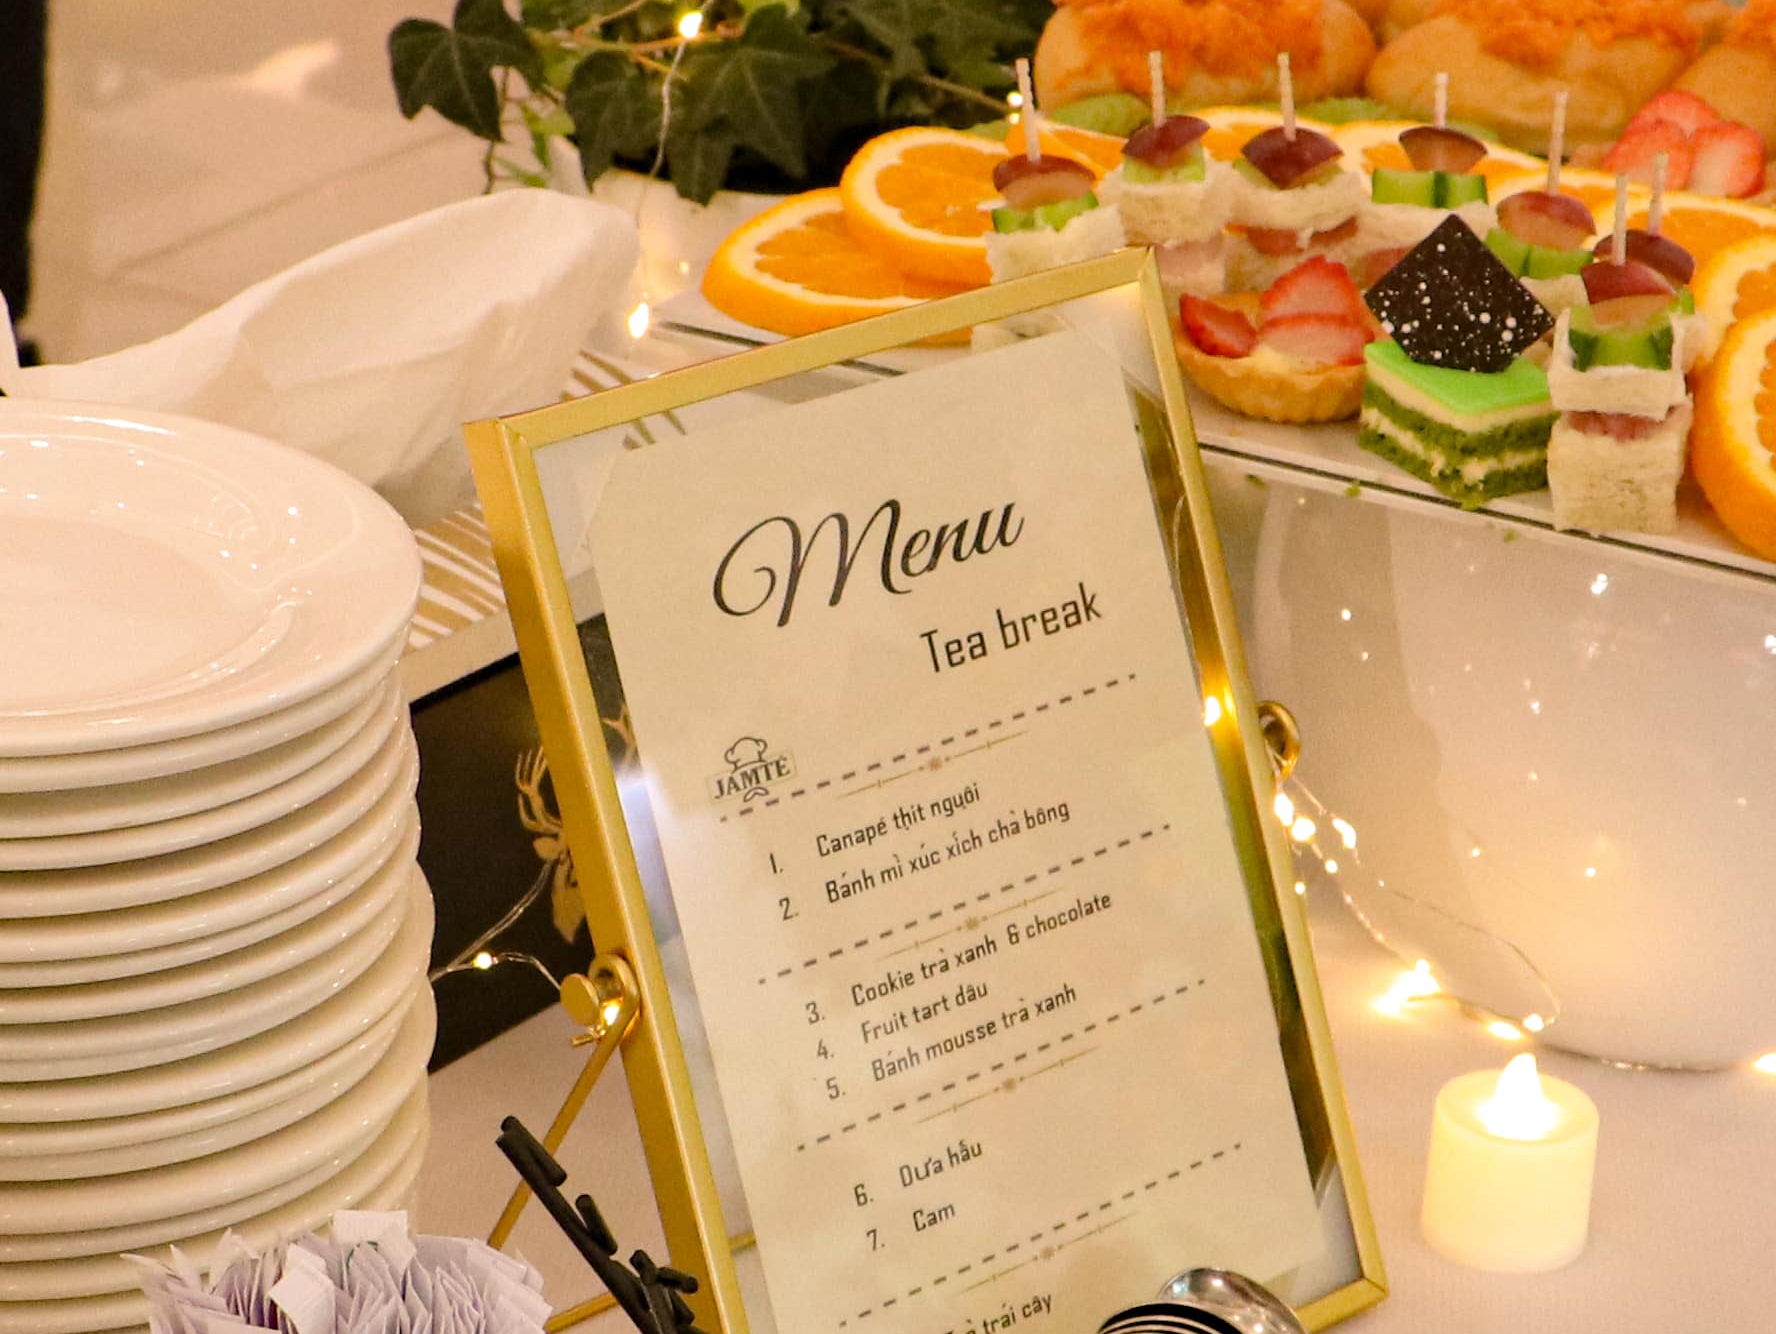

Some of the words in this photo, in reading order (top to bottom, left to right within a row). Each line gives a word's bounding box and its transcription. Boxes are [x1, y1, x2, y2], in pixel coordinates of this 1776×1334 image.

[711, 498, 1025, 628] Menu
[919, 628, 989, 674] Tea
[995, 581, 1103, 652] break
[769, 852, 784, 874] 1.
[815, 817, 889, 858] Canapé
[892, 802, 927, 831] thịt
[930, 781, 981, 818] nguội
[778, 896, 800, 921] 2.
[825, 866, 876, 904] Bánh
[880, 853, 905, 885] mì
[908, 841, 942, 875] xúc
[946, 829, 984, 860] xích
[988, 808, 1022, 845] chà
[1023, 801, 1071, 831] bông
[804, 1000, 826, 1026] 3.
[850, 969, 916, 1008] Cookie
[920, 948, 951, 979] trà
[953, 934, 998, 969] xanh
[1006, 922, 1021, 946] &
[1025, 892, 1113, 940] chocolate
[815, 1037, 835, 1061] 4.
[861, 1008, 909, 1045] Fruit
[911, 995, 952, 1023] tart
[954, 982, 989, 1009] dâu
[825, 1076, 847, 1101] 5.
[871, 1049, 922, 1083] Bánh
[925, 1019, 998, 1063] mousse
[1001, 997, 1031, 1030] trà
[1033, 984, 1077, 1019] xanh
[853, 1183, 874, 1208] 6.
[946, 1138, 984, 1169] hấu
[865, 1227, 886, 1253] 7.
[911, 1203, 957, 1233] Cam
[1021, 1293, 1054, 1320] cây
